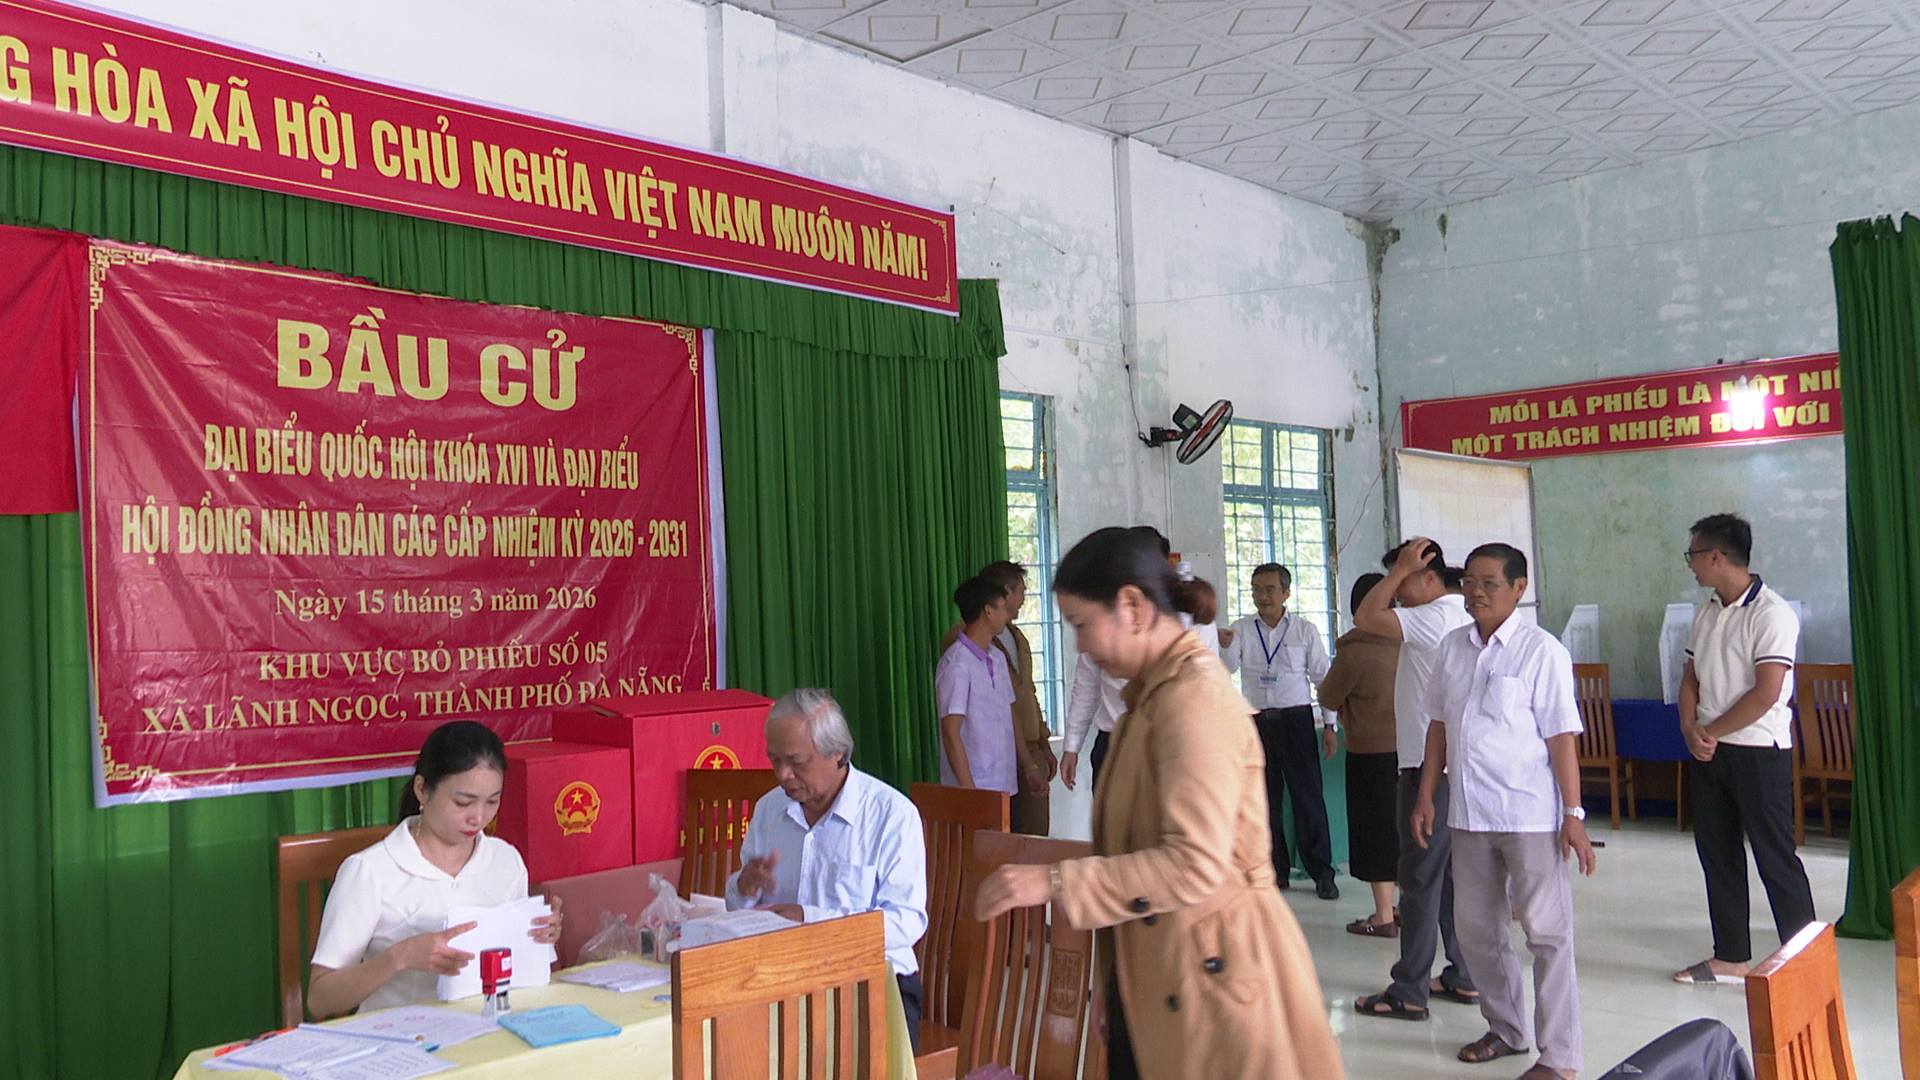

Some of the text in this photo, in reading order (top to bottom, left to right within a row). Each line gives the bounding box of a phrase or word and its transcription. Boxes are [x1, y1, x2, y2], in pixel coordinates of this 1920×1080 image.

[52, 42, 173, 133] HÒA
[186, 75, 261, 151] XÃ
[273, 95, 357, 179] HỘI
[370, 116, 460, 189] CHỦ
[472, 141, 597, 217] NGHĨA
[603, 166, 678, 239] VIỆT
[688, 186, 765, 247] NAM
[771, 205, 855, 266] MUÔN
[860, 220, 928, 281] NĂM!
[277, 307, 585, 411] BẦU CỬ
[1452, 433, 1505, 457] MỘT
[1512, 427, 1599, 451] TRÁCH
[1609, 415, 1699, 442] NHIỆM
[1773, 401, 1829, 427] VỚI
[1548, 395, 1578, 418] LÁ
[1586, 385, 1667, 415] PHIẾU
[1678, 382, 1711, 405] LÀ
[204, 411, 639, 496] ĐẠI BIỂU QUỐC HỘI KHÓA XVI VÀ ĐẠI BIỂU
[122, 495, 169, 565] HỘI
[178, 491, 252, 555] ĐỒNG
[260, 501, 330, 555] NHÂN
[336, 503, 385, 556] DÂN
[393, 505, 437, 557] CÁC
[443, 500, 486, 557] CẤP
[493, 508, 555, 567] NHIỆM
[562, 510, 584, 557] KỲ
[590, 519, 634, 557] 2026
[649, 519, 688, 557] 2031
[274, 586, 597, 622] Ngày 15 tháng 3 năm 2026
[259, 631, 608, 682] KHU VỰC BỎ PHIẾU SỐ 05
[142, 666, 682, 733] XÃ LÃNH NGỌC, THÀNH PHỐ ĐÀ NẴNG
